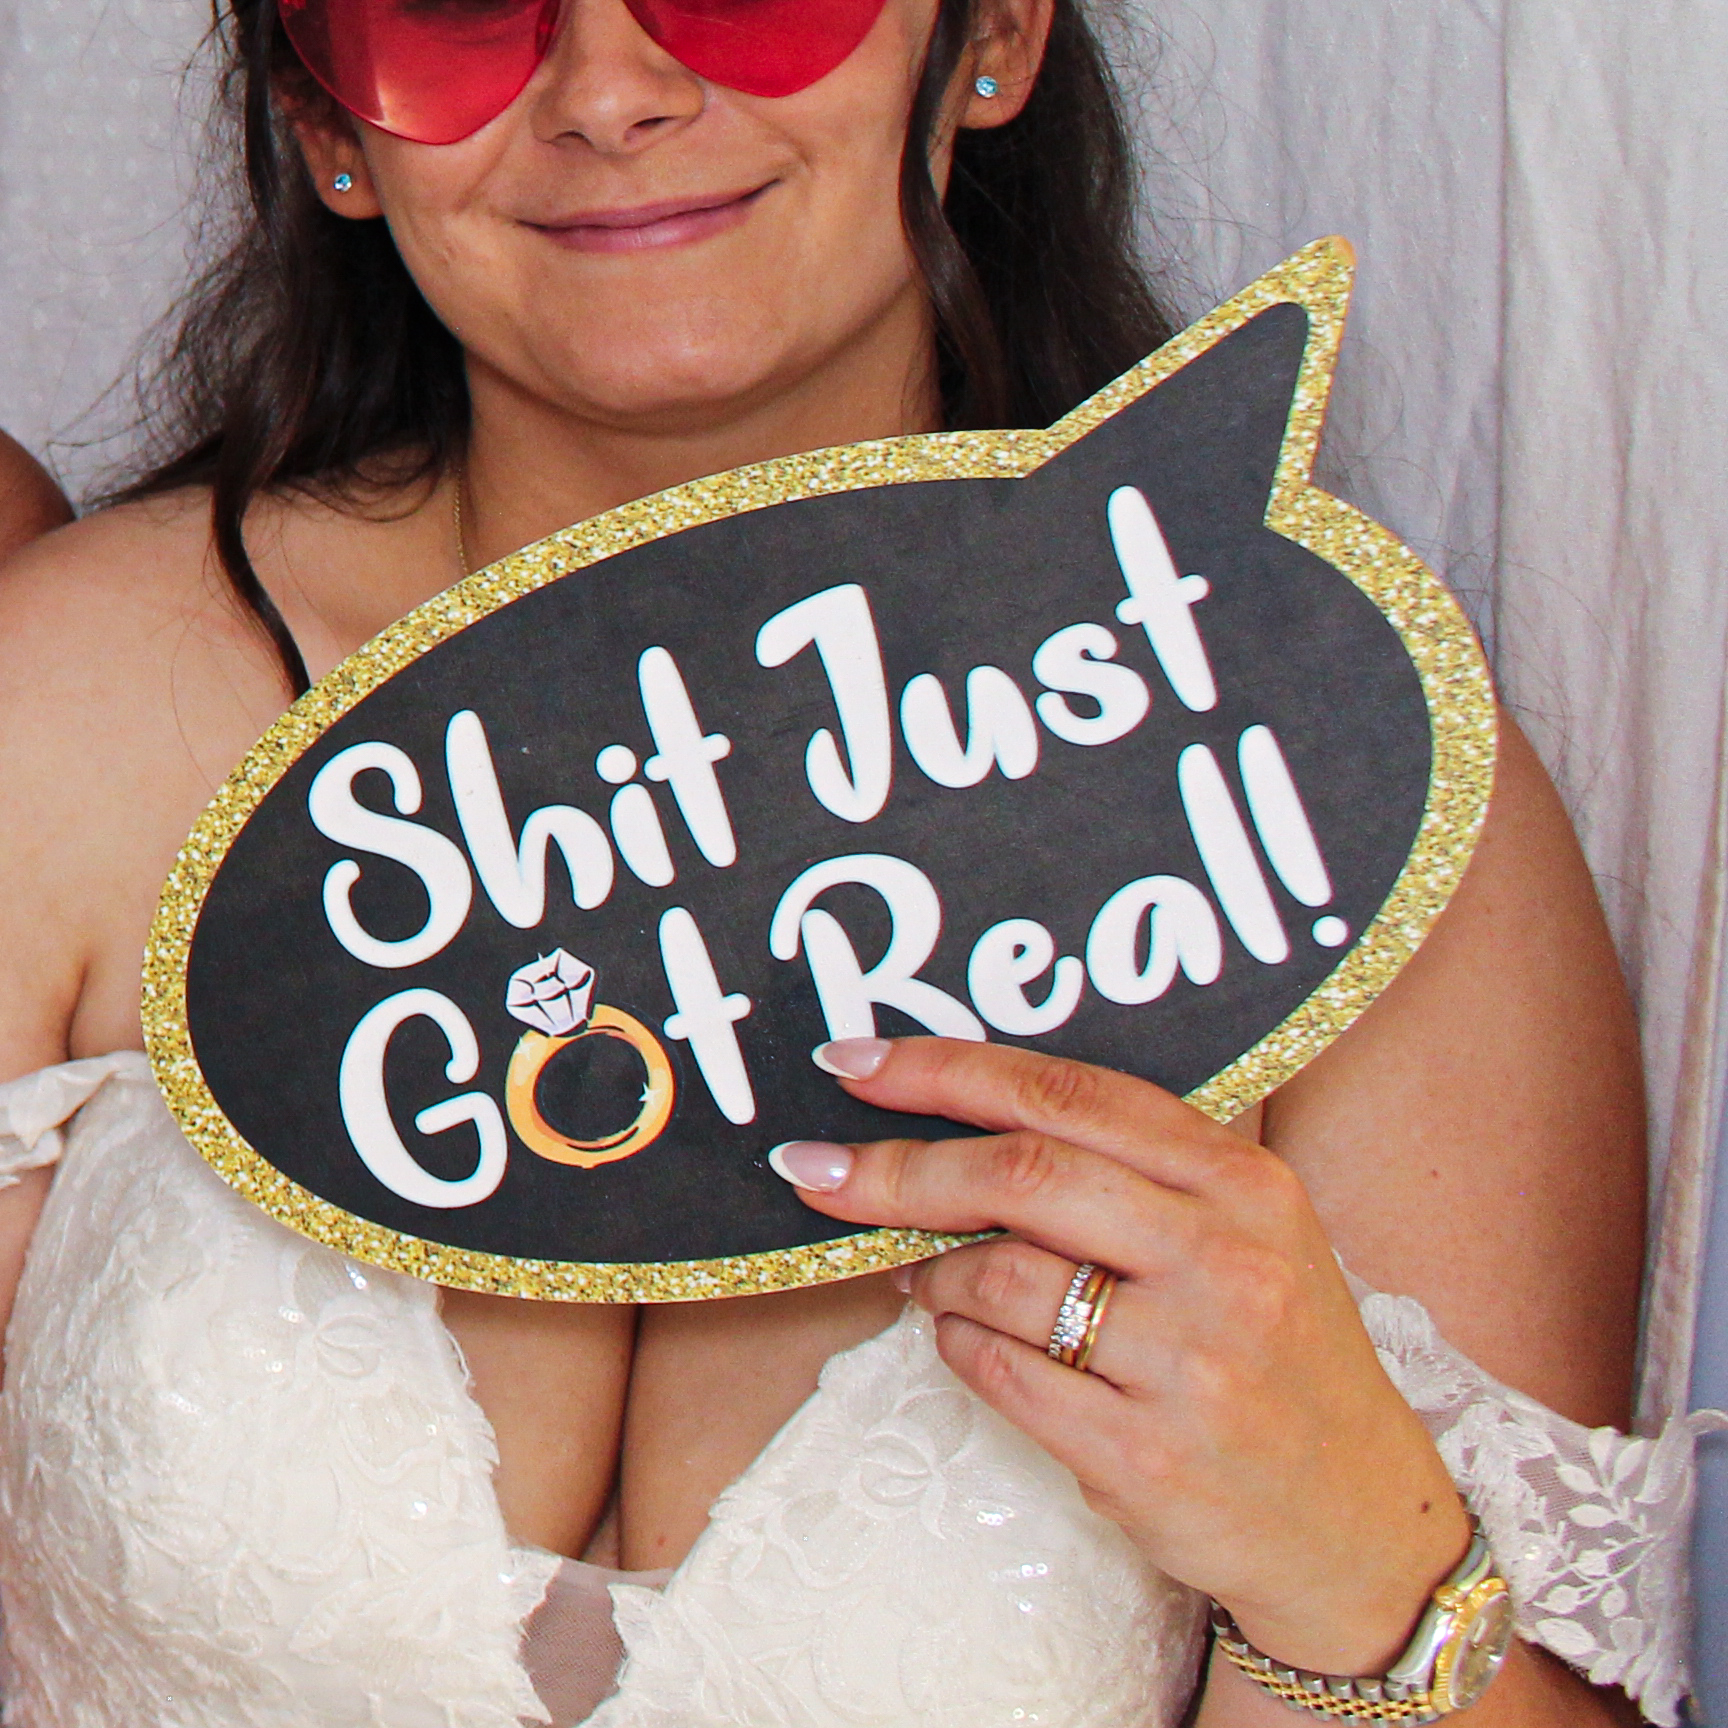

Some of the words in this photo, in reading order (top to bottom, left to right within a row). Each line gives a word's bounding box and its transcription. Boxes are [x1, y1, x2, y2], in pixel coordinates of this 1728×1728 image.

[308, 645, 738, 969] Shit
[755, 484, 1217, 824] Just
[769, 724, 1348, 1048] Real!
